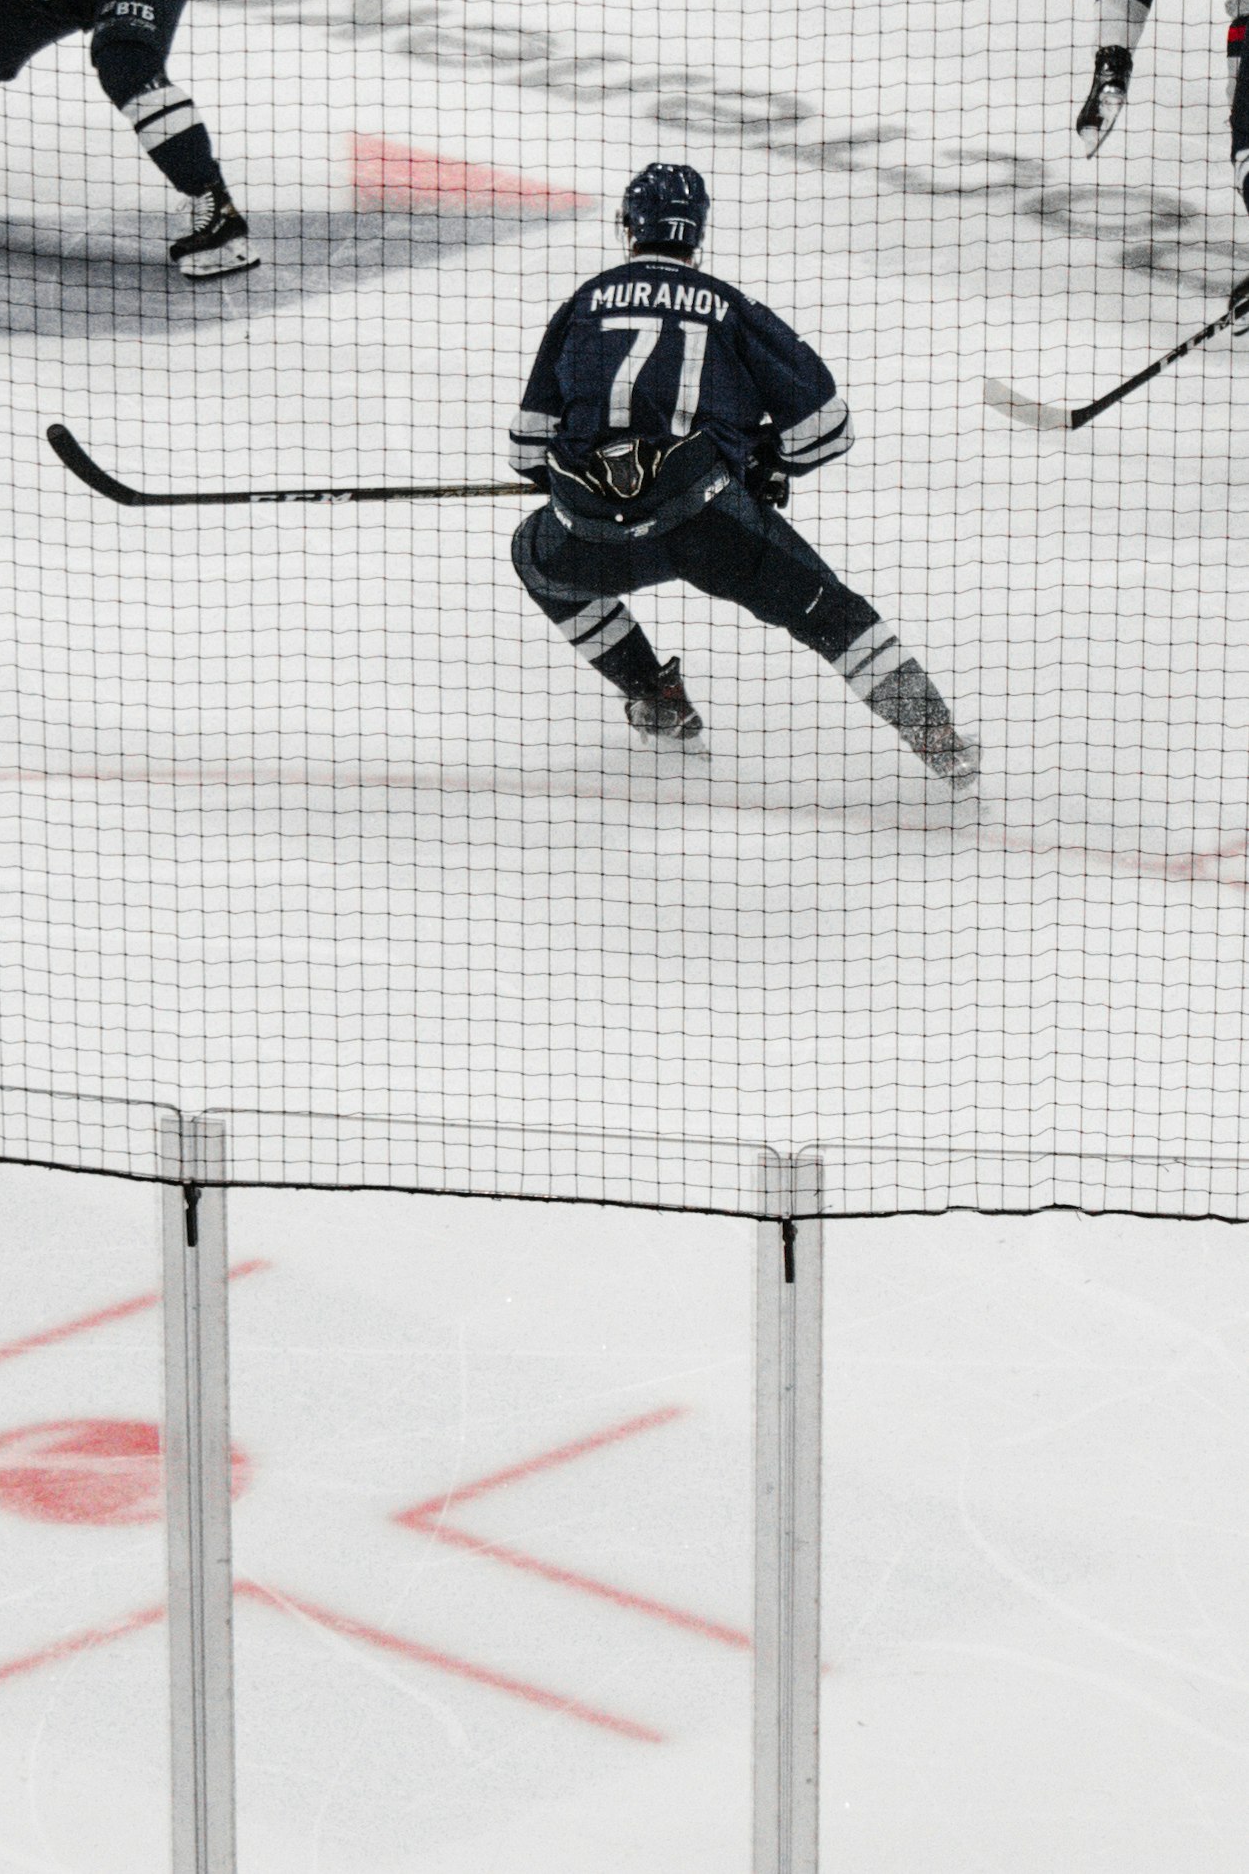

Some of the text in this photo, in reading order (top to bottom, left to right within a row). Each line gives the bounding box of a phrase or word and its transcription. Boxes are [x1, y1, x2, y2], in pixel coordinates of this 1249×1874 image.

[116, 1, 155, 21] ВТБ
[668, 222, 685, 240] 71
[590, 283, 729, 322] MURANOV
[600, 317, 709, 437] 71
